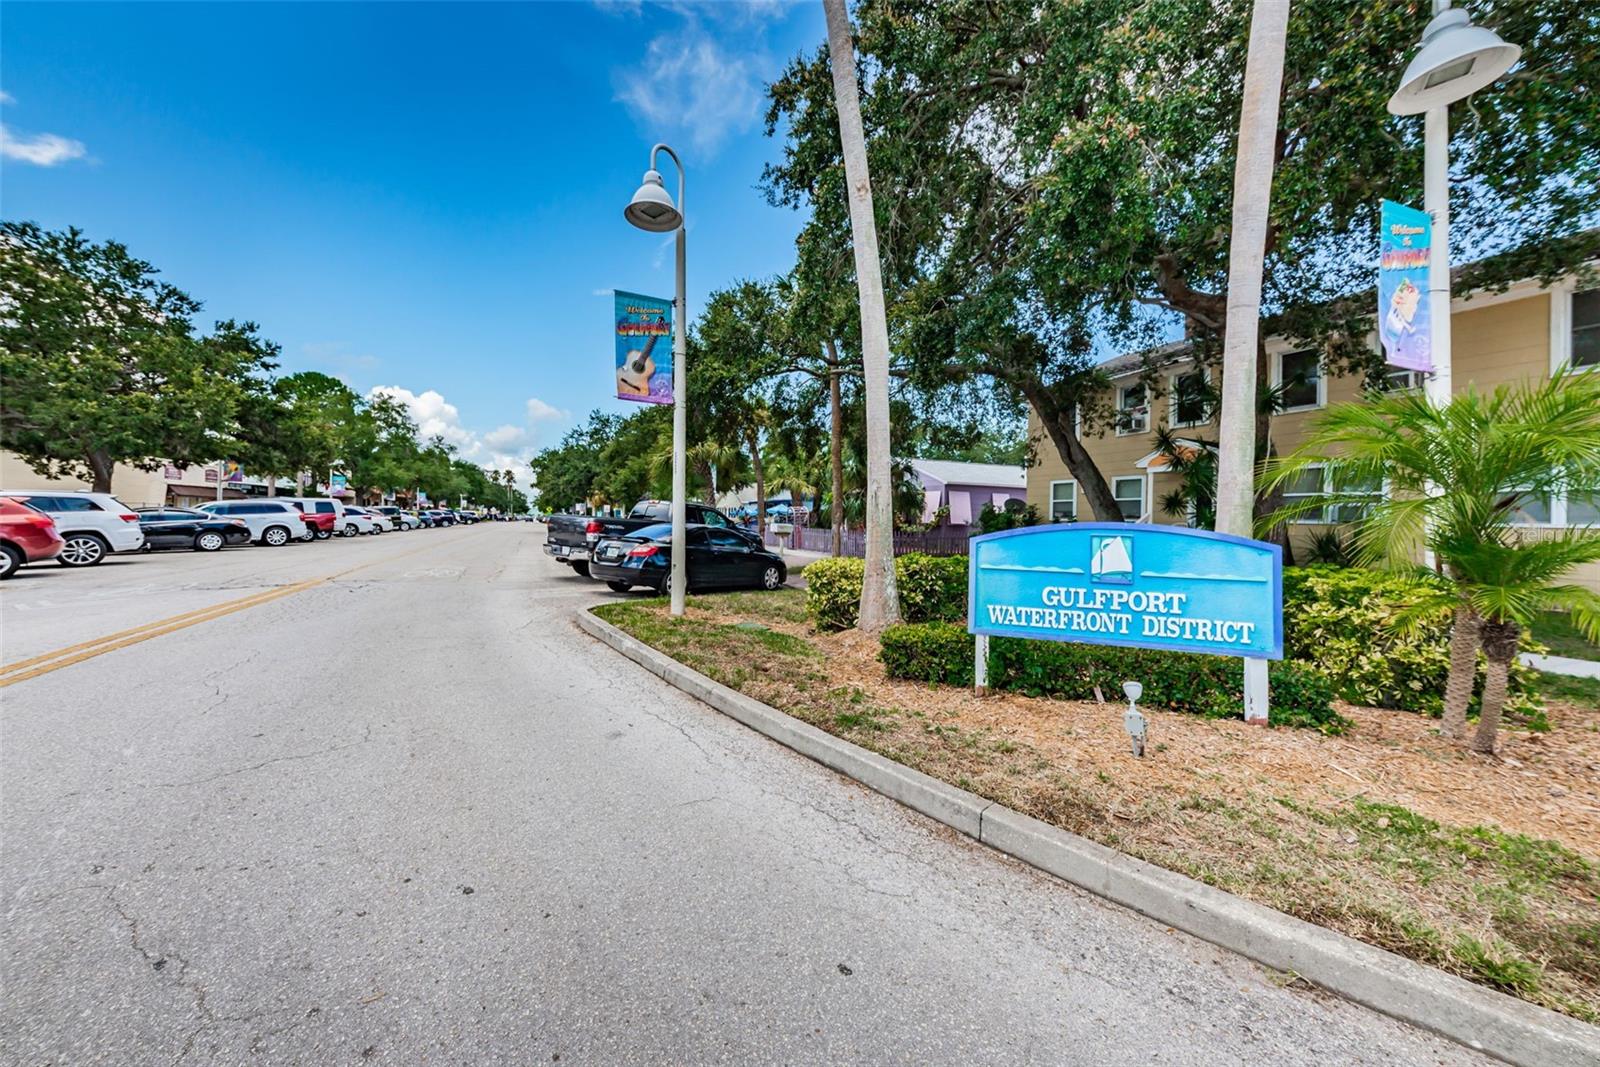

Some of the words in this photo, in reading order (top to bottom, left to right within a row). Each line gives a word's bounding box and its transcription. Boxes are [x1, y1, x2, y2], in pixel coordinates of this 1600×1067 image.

[1391, 224, 1425, 235] Welcome
[625, 305, 664, 314] Welcome
[1042, 586, 1186, 614] GULFPORT
[987, 604, 1132, 634] WATERFRONT
[1142, 615, 1255, 644] DISTRICT
